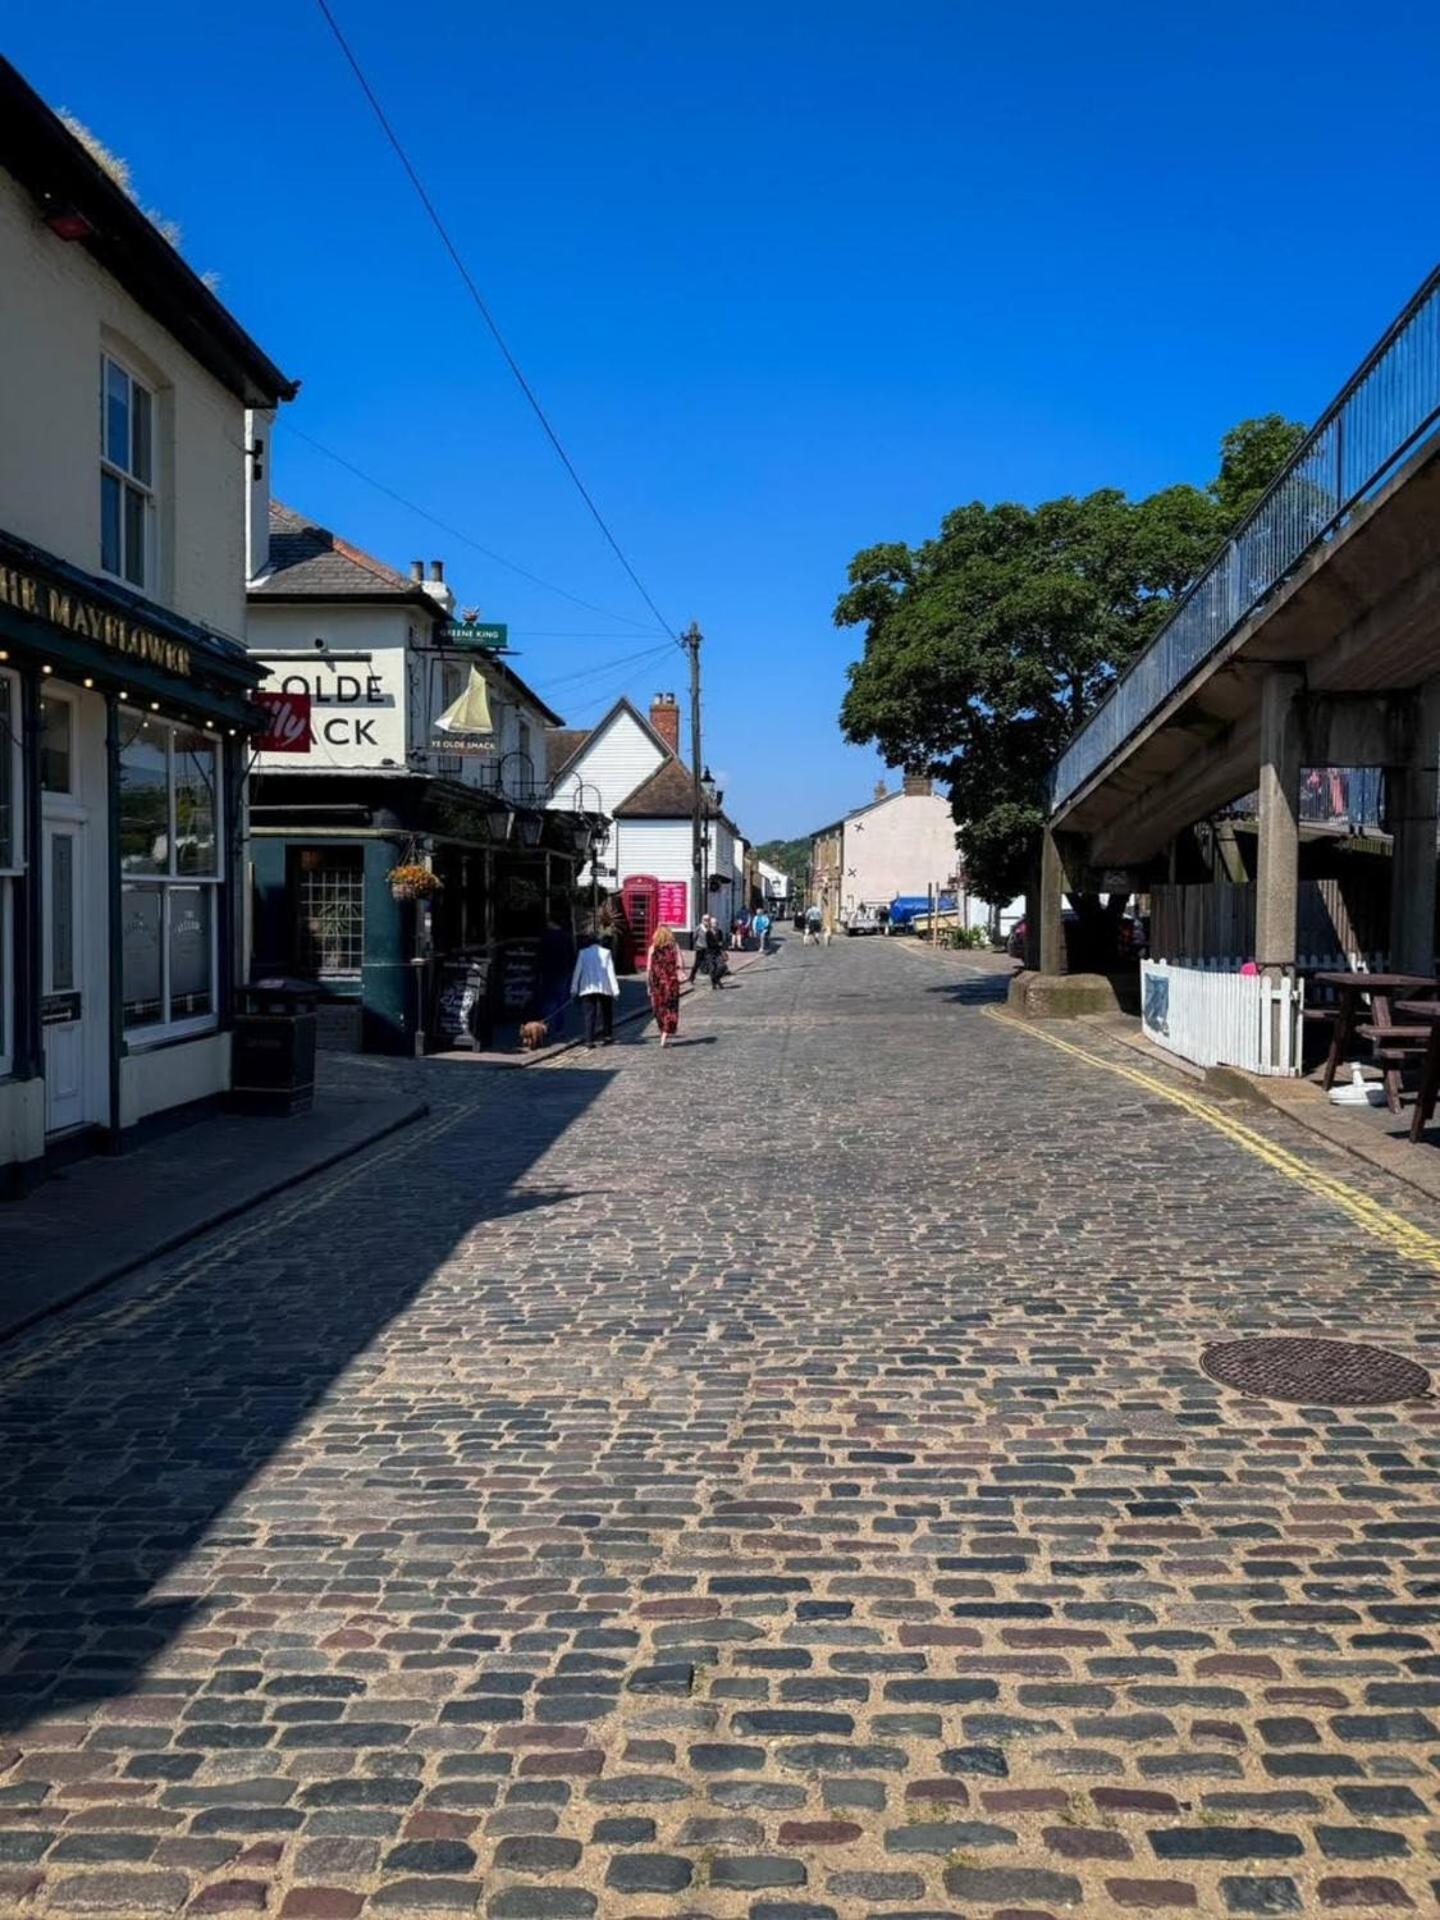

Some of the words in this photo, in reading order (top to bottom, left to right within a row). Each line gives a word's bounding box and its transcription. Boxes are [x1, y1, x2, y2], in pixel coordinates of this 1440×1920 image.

[49, 587, 192, 677] MAYFLOWER
[440, 629, 474, 638] GREENE
[476, 630, 499, 639] KING
[281, 675, 386, 703] OLDE
[262, 698, 307, 747] lly
[311, 718, 378, 745] CK
[432, 740, 441, 748] YE
[443, 740, 464, 749] OLDE
[467, 741, 496, 750] SMACK
